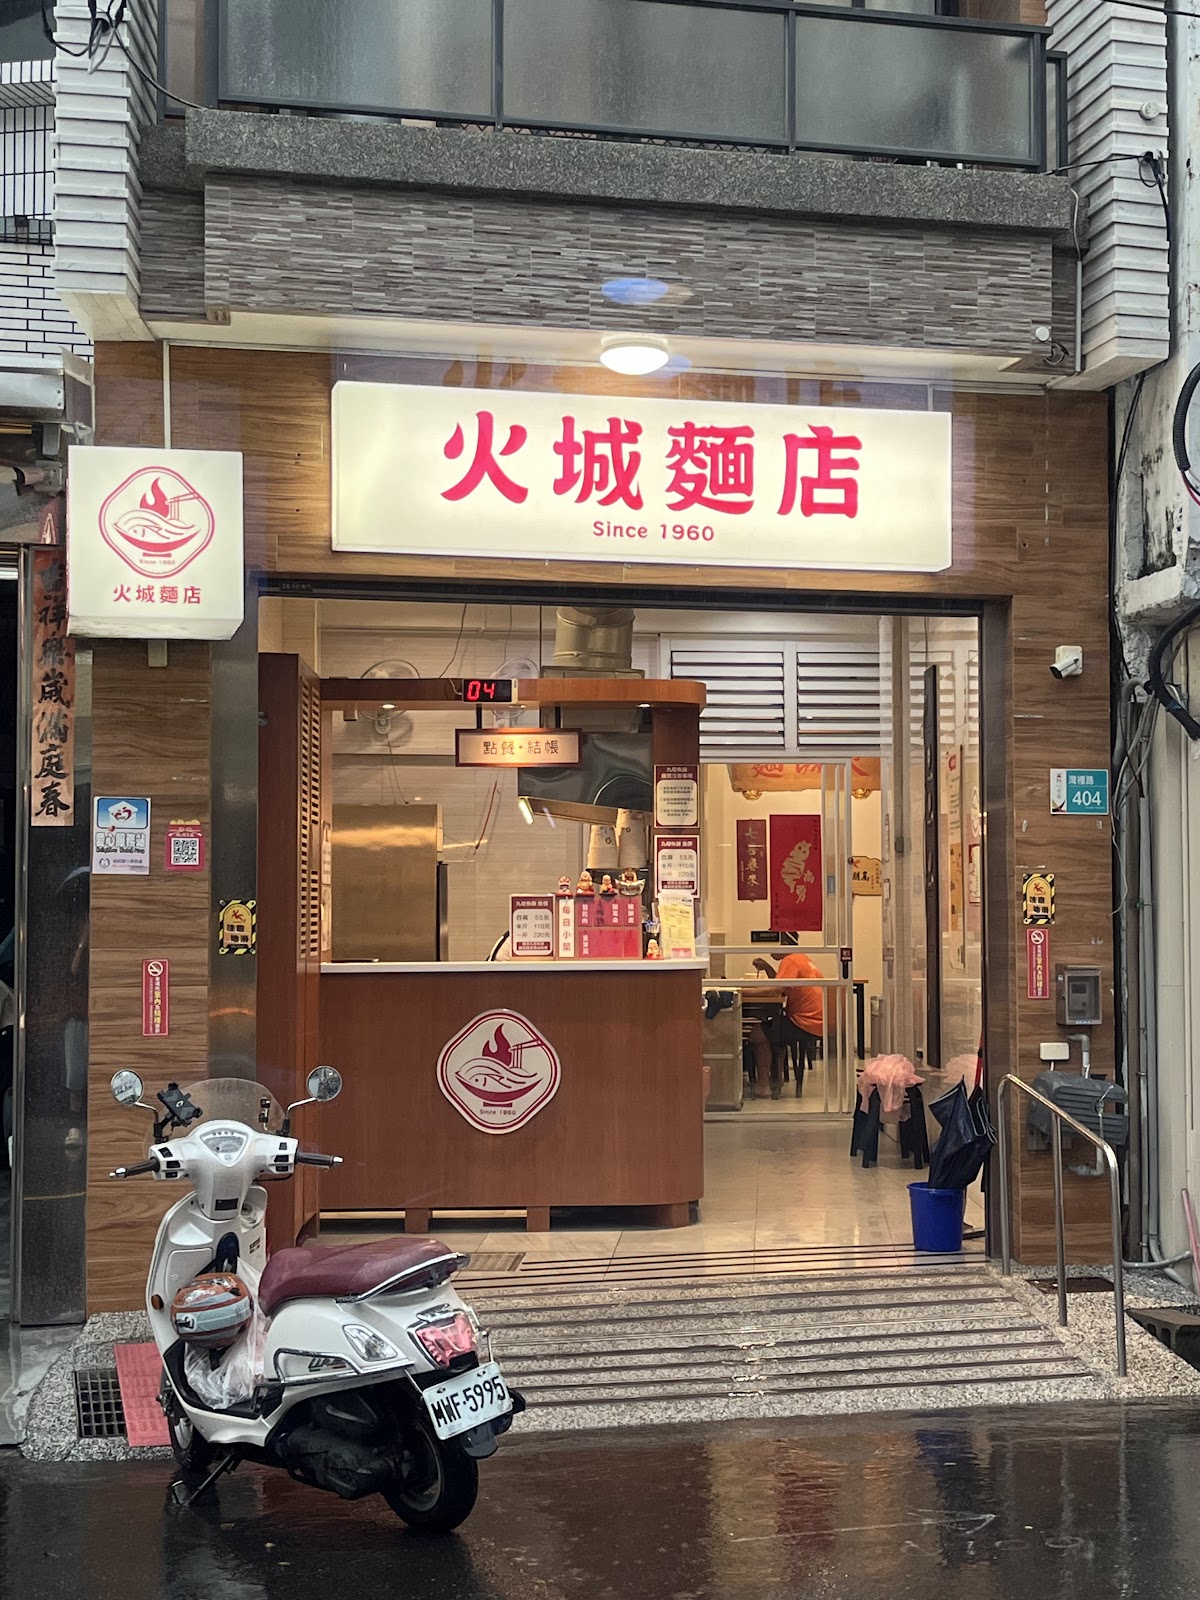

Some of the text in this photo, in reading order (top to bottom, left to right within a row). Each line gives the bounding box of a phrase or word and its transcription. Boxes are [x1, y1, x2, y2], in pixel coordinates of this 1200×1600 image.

[440, 410, 863, 518] 火城麵店
[592, 520, 715, 541] Since 1960
[112, 583, 203, 605] 火城麵店
[466, 680, 497, 702] 04
[1071, 790, 1102, 806] 404
[562, 905, 571, 952] 每日小菜
